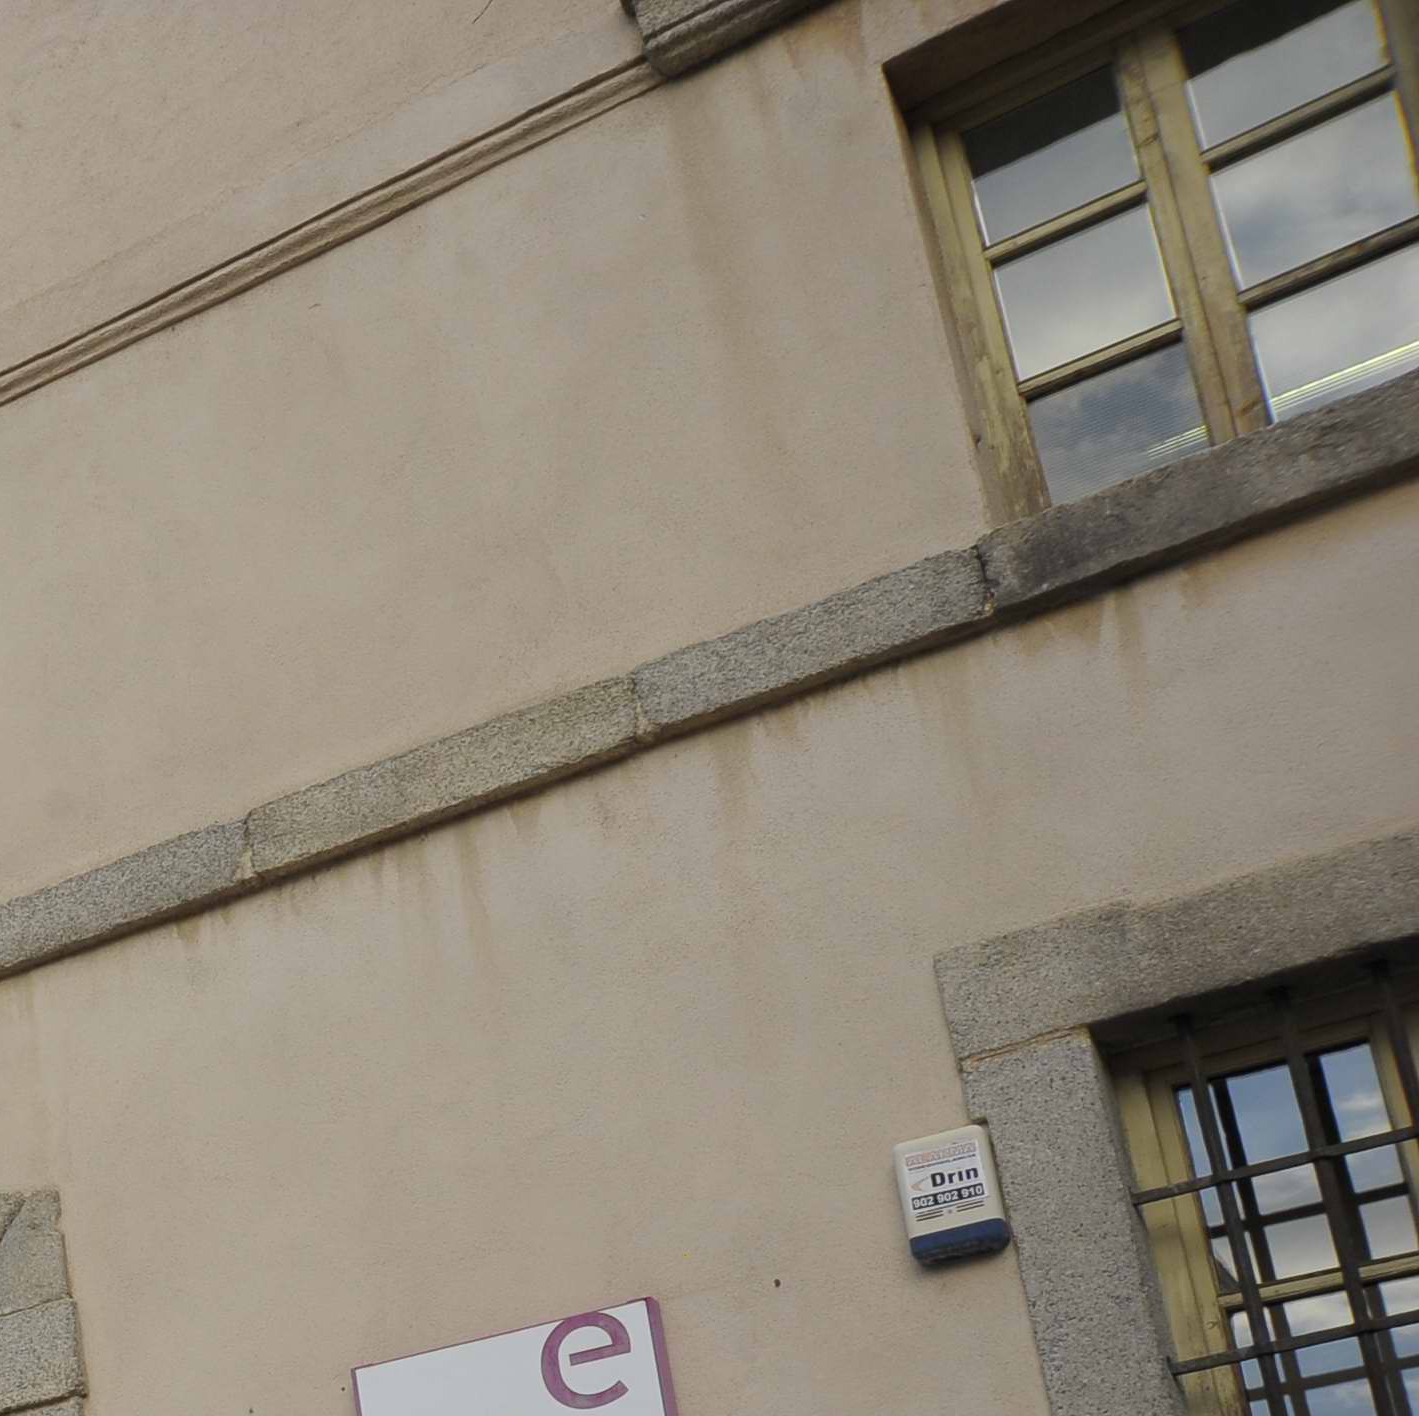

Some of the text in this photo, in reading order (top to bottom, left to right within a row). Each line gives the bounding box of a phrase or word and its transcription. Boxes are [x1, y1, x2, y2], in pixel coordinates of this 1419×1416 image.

[913, 1185, 983, 1209] 902 902 910
[540, 1310, 632, 1410] e
